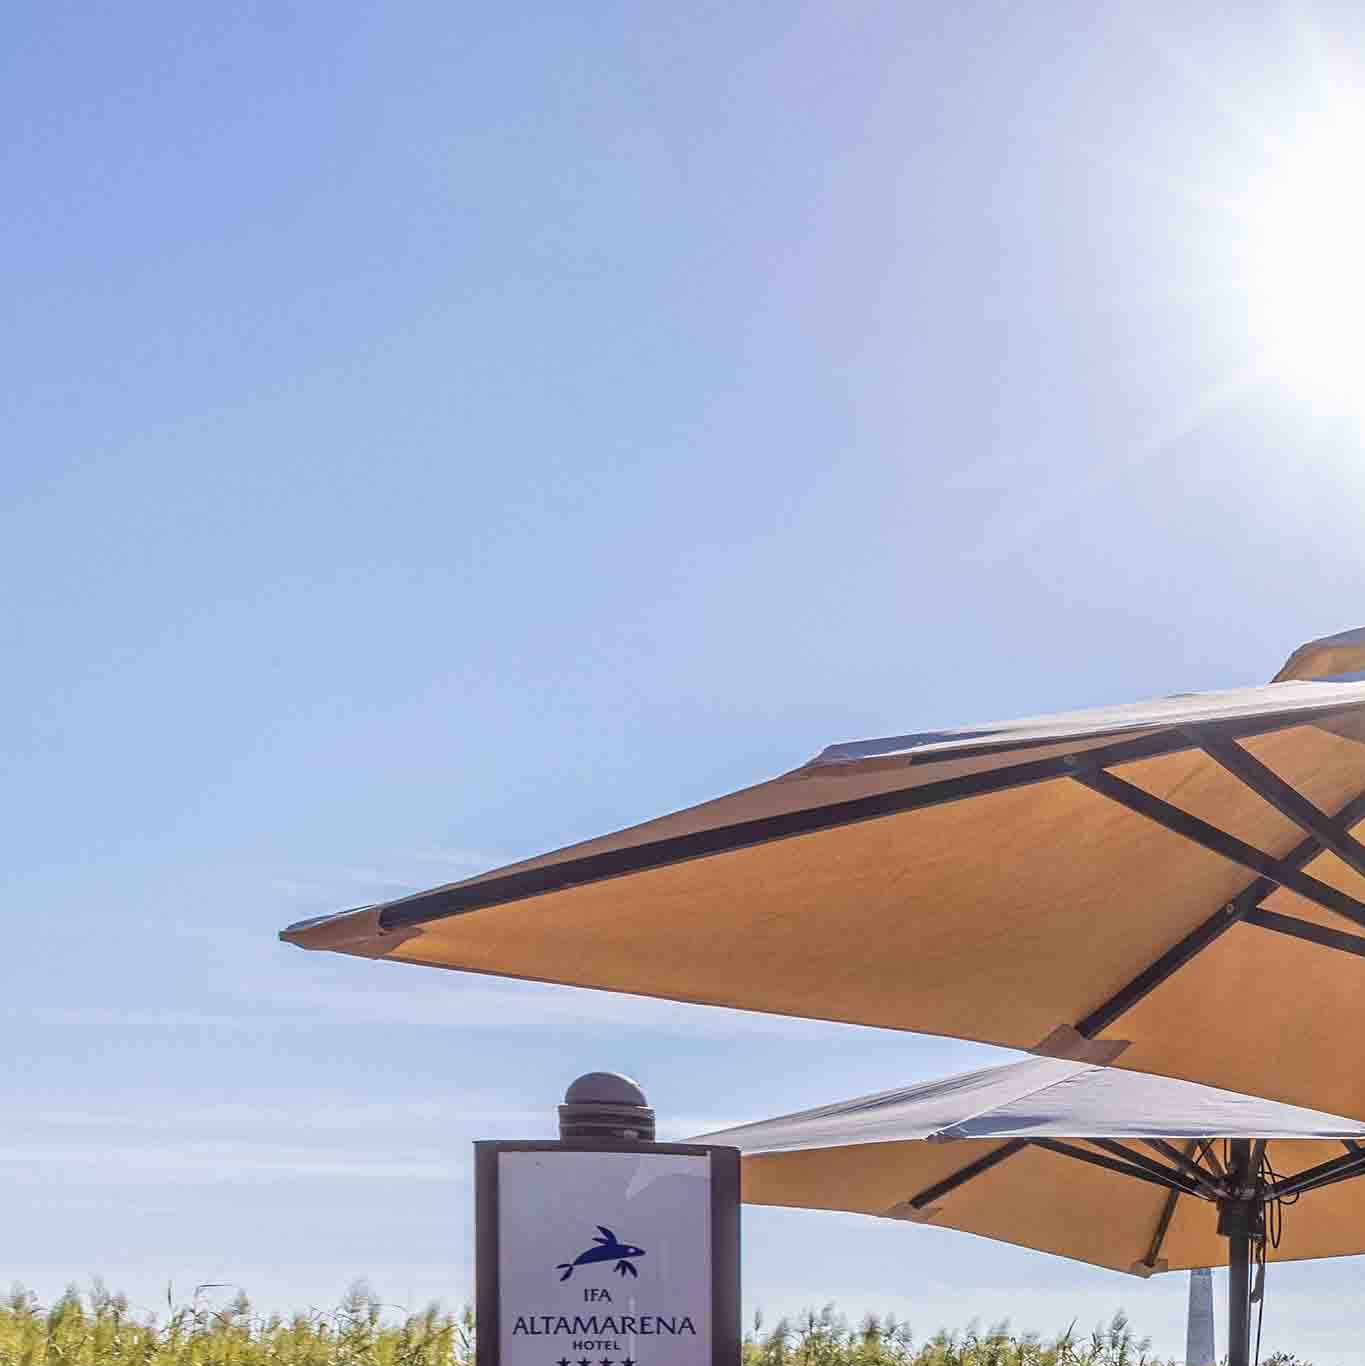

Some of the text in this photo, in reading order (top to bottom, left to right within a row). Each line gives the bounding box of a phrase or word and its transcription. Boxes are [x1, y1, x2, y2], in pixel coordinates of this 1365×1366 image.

[583, 1288, 612, 1302] IFA
[512, 1316, 697, 1335] ALTAMARENA
[572, 1340, 622, 1351] HOTEL
